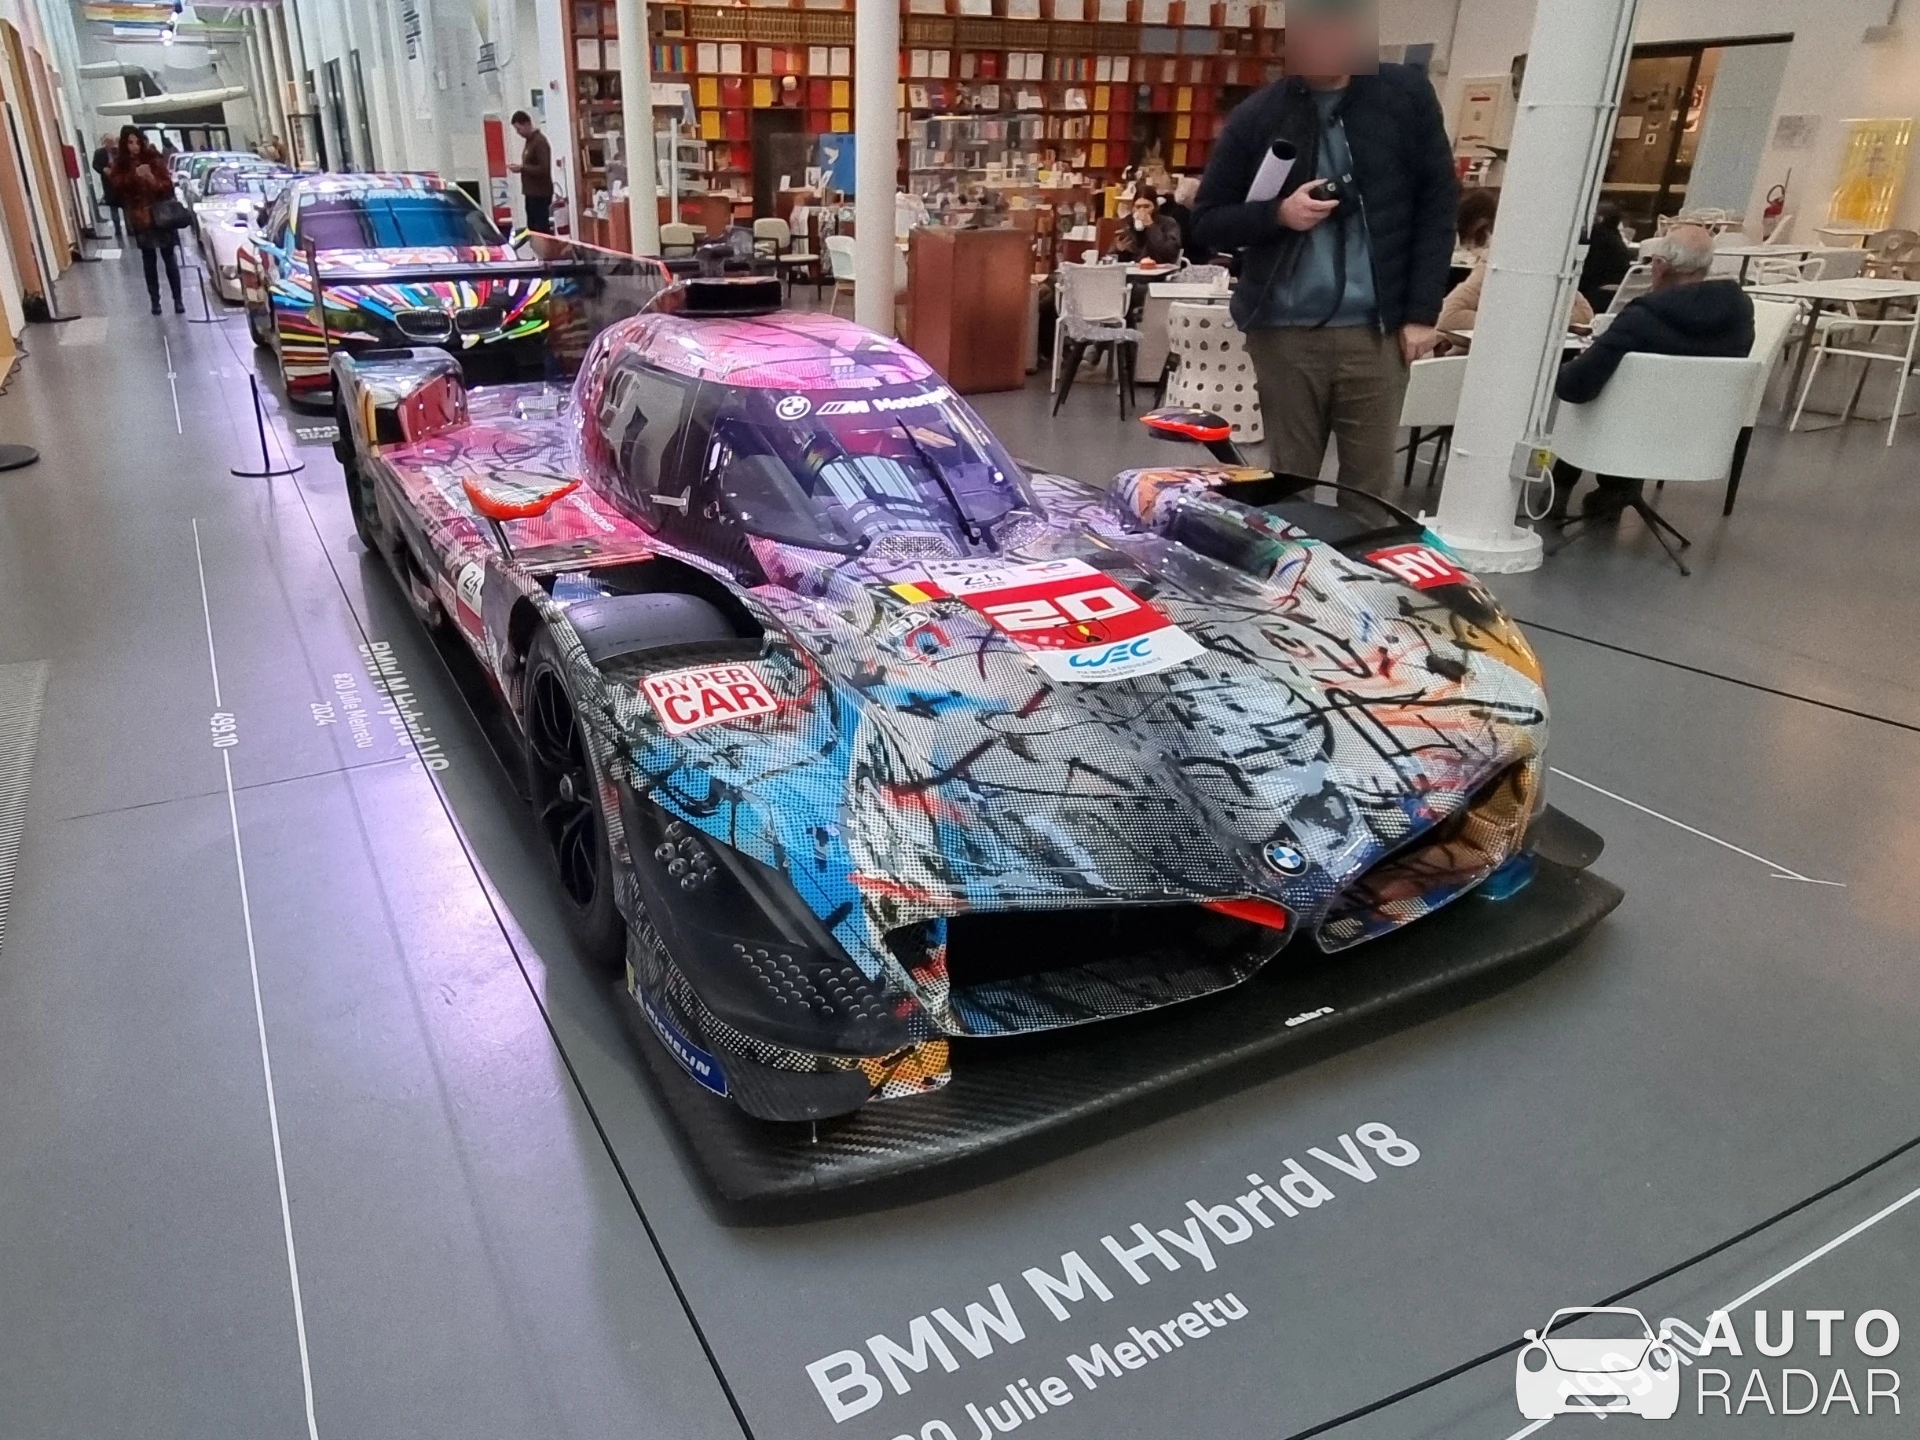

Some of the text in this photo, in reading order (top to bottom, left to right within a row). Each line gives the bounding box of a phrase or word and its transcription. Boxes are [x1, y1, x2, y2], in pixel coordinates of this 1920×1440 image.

[1377, 550, 1452, 582] HY
[983, 586, 1141, 632] 20
[1069, 637, 1152, 667] WEC
[650, 668, 750, 698] HYPER
[664, 683, 769, 725] CAR
[310, 700, 337, 727] 2024
[332, 672, 375, 749] #20 Julie Mehretu
[358, 641, 450, 773] BMW M Hybrid V8
[210, 711, 239, 748] 499.10
[645, 1002, 711, 1077] MICHELIN
[804, 1121, 1421, 1424] BMW M Hybrid V8
[964, 1292, 1249, 1440] Julie Mehretu
